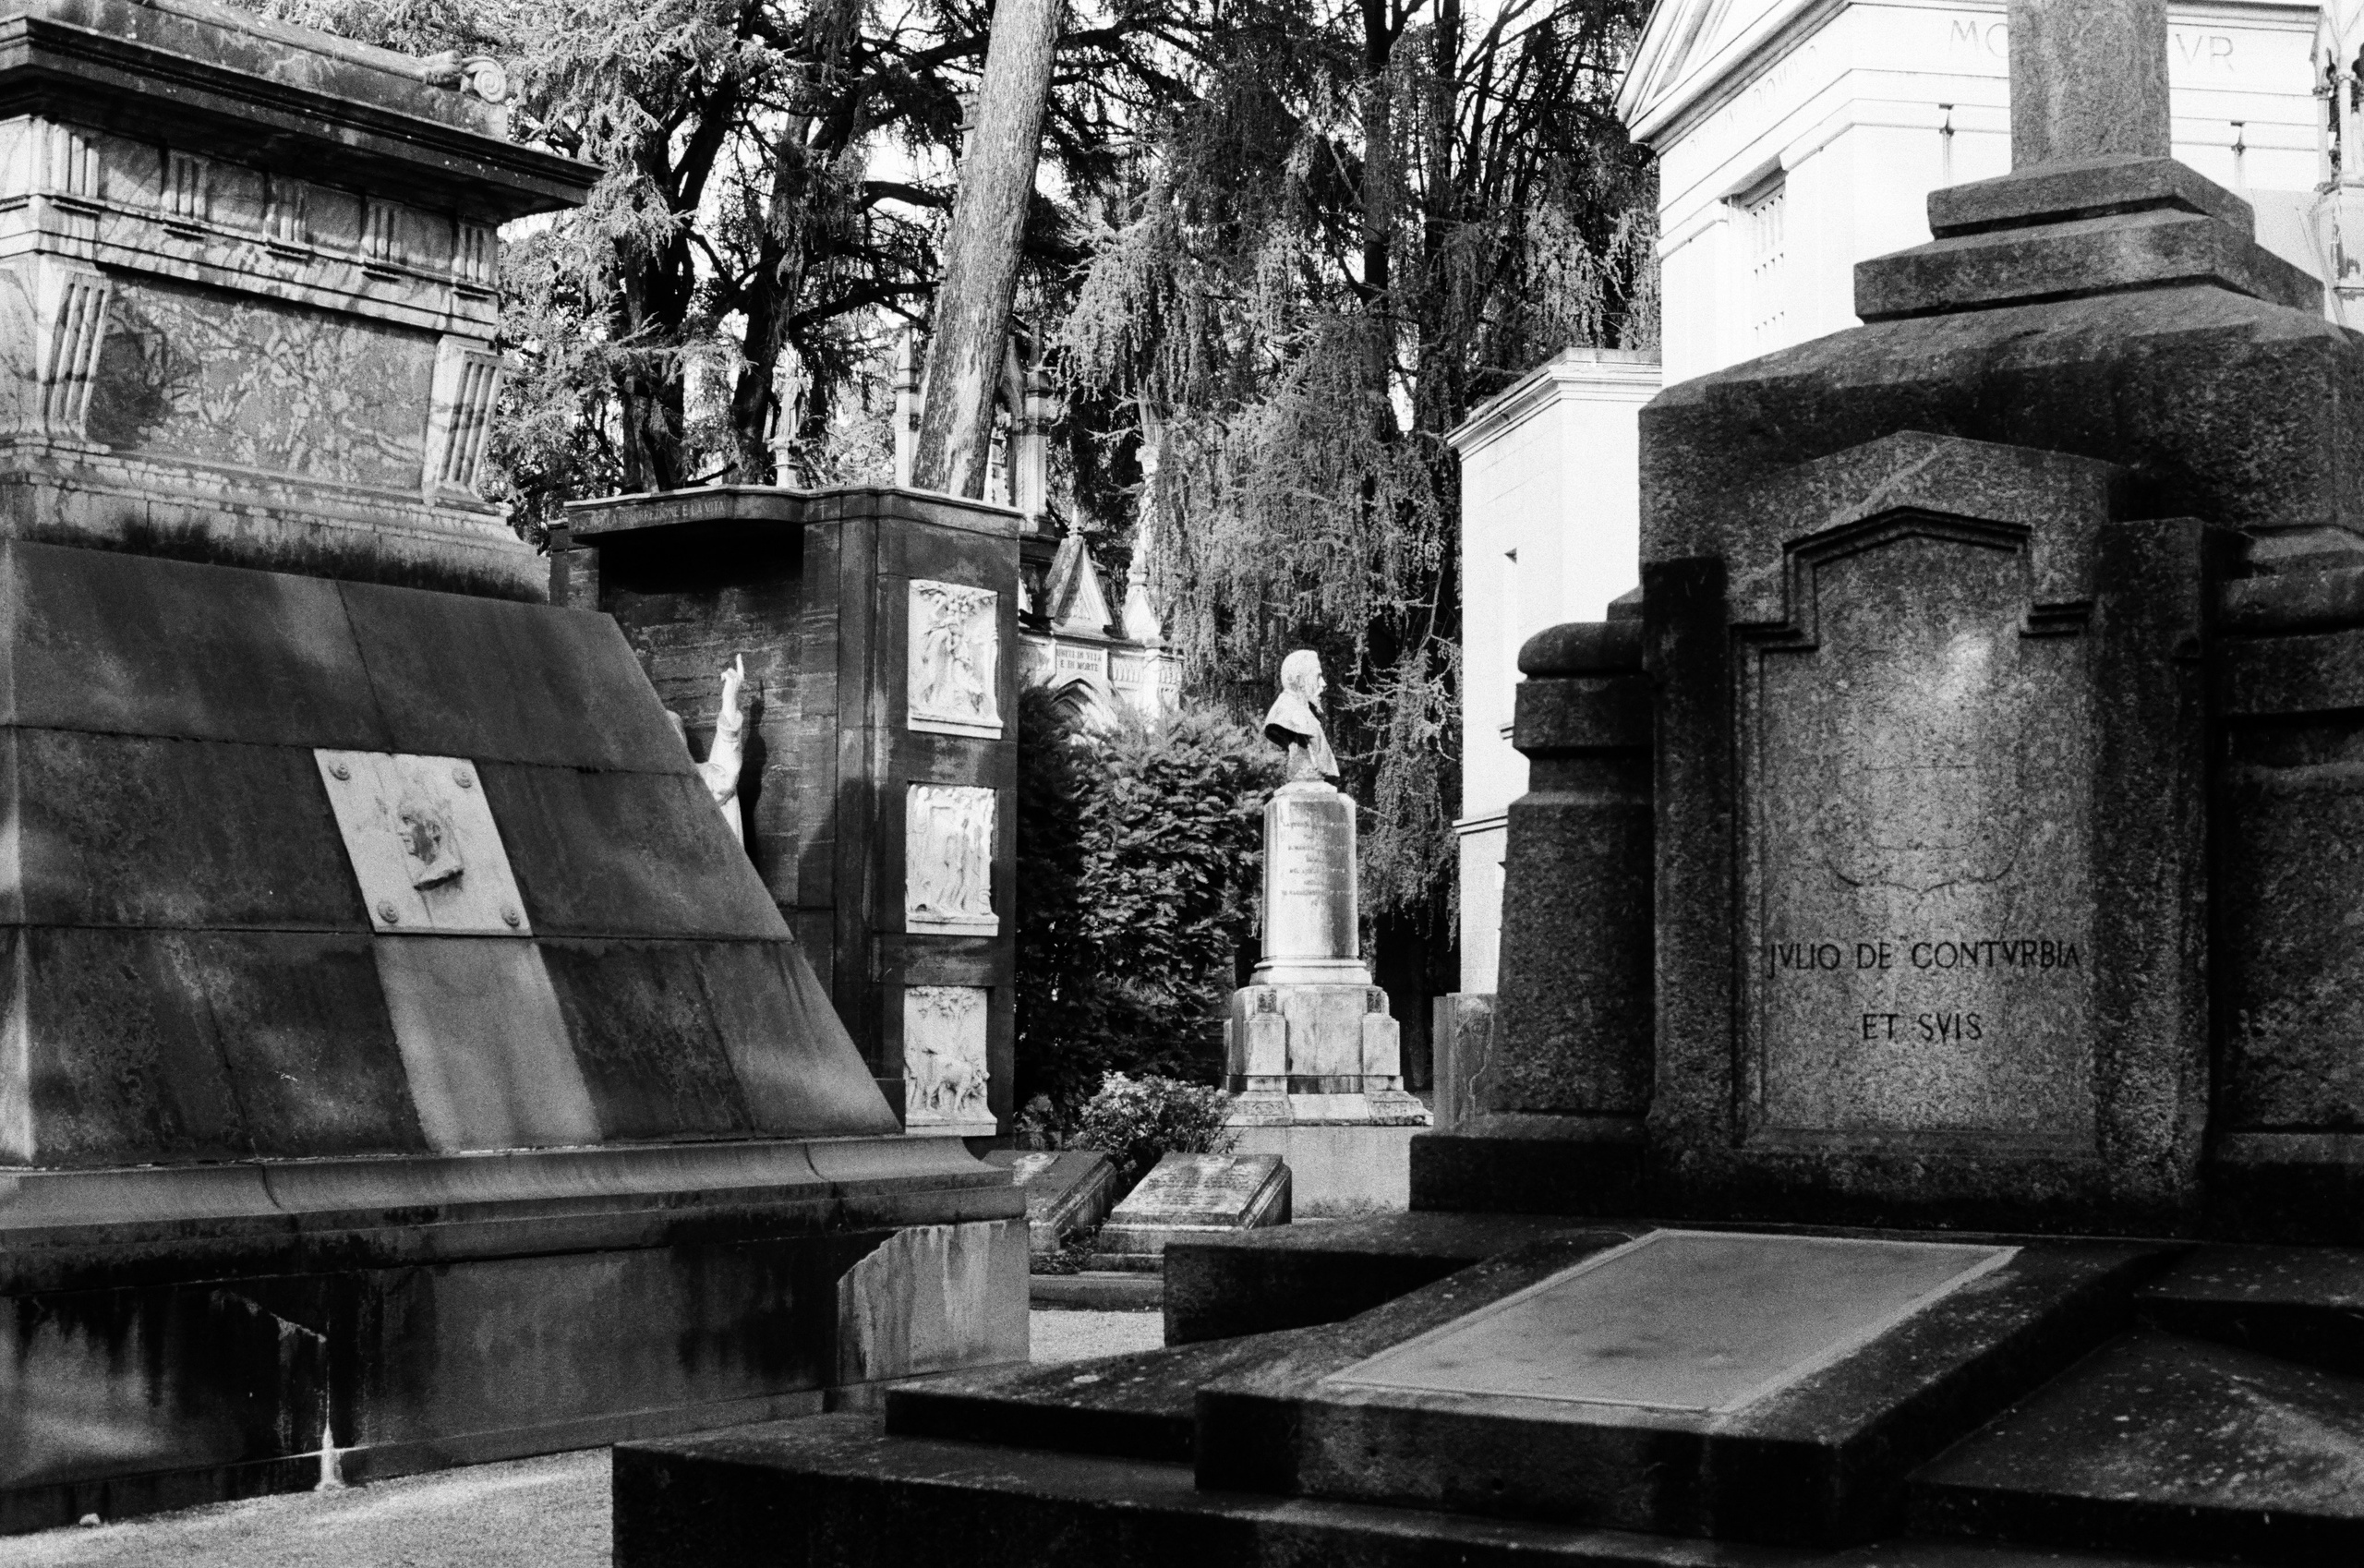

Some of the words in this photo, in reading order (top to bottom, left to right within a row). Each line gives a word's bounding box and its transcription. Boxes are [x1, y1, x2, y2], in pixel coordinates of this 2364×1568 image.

[704, 501, 726, 514] VITA
[1856, 941, 1893, 970] DE
[1911, 940, 2081, 970] CONTVRBIA
[1862, 1013, 1900, 1041] ET
[1917, 1012, 1984, 1043] SVIS
